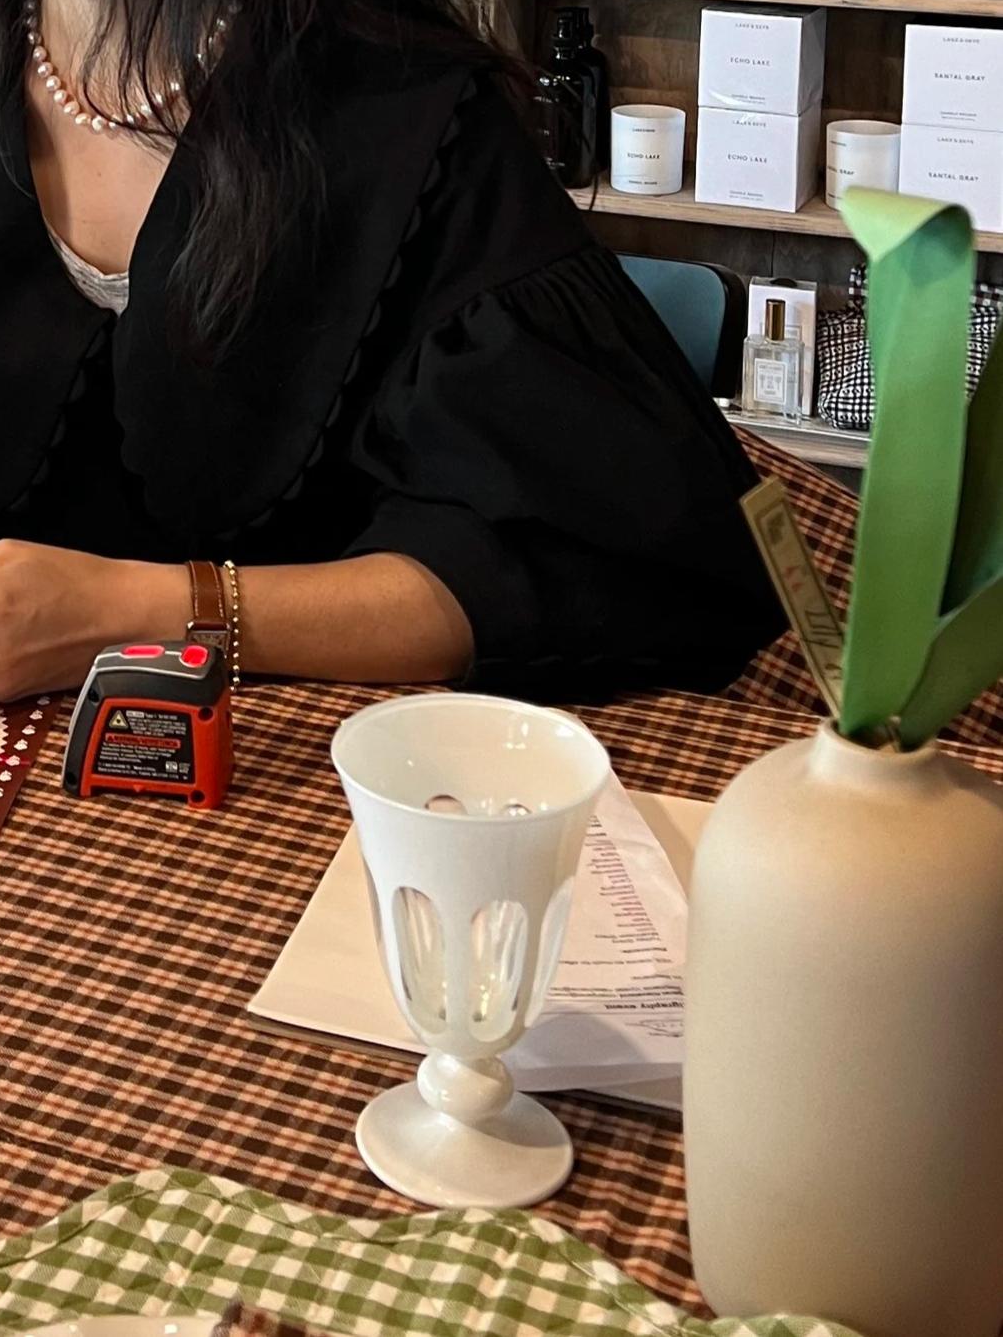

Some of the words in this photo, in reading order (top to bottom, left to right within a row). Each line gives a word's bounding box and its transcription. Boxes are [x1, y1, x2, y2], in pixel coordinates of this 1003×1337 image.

[730, 57, 751, 65] ECHO
[752, 59, 771, 67] LAKE
[934, 73, 963, 81] SANTAL
[965, 74, 986, 82] GRAY
[627, 152, 643, 160] ECHO
[727, 154, 748, 162] ECHO
[749, 156, 768, 164] LAKE
[928, 172, 956, 181] SANTAL
[958, 174, 979, 182] GRAY
[604, 1003, 637, 1011] event
